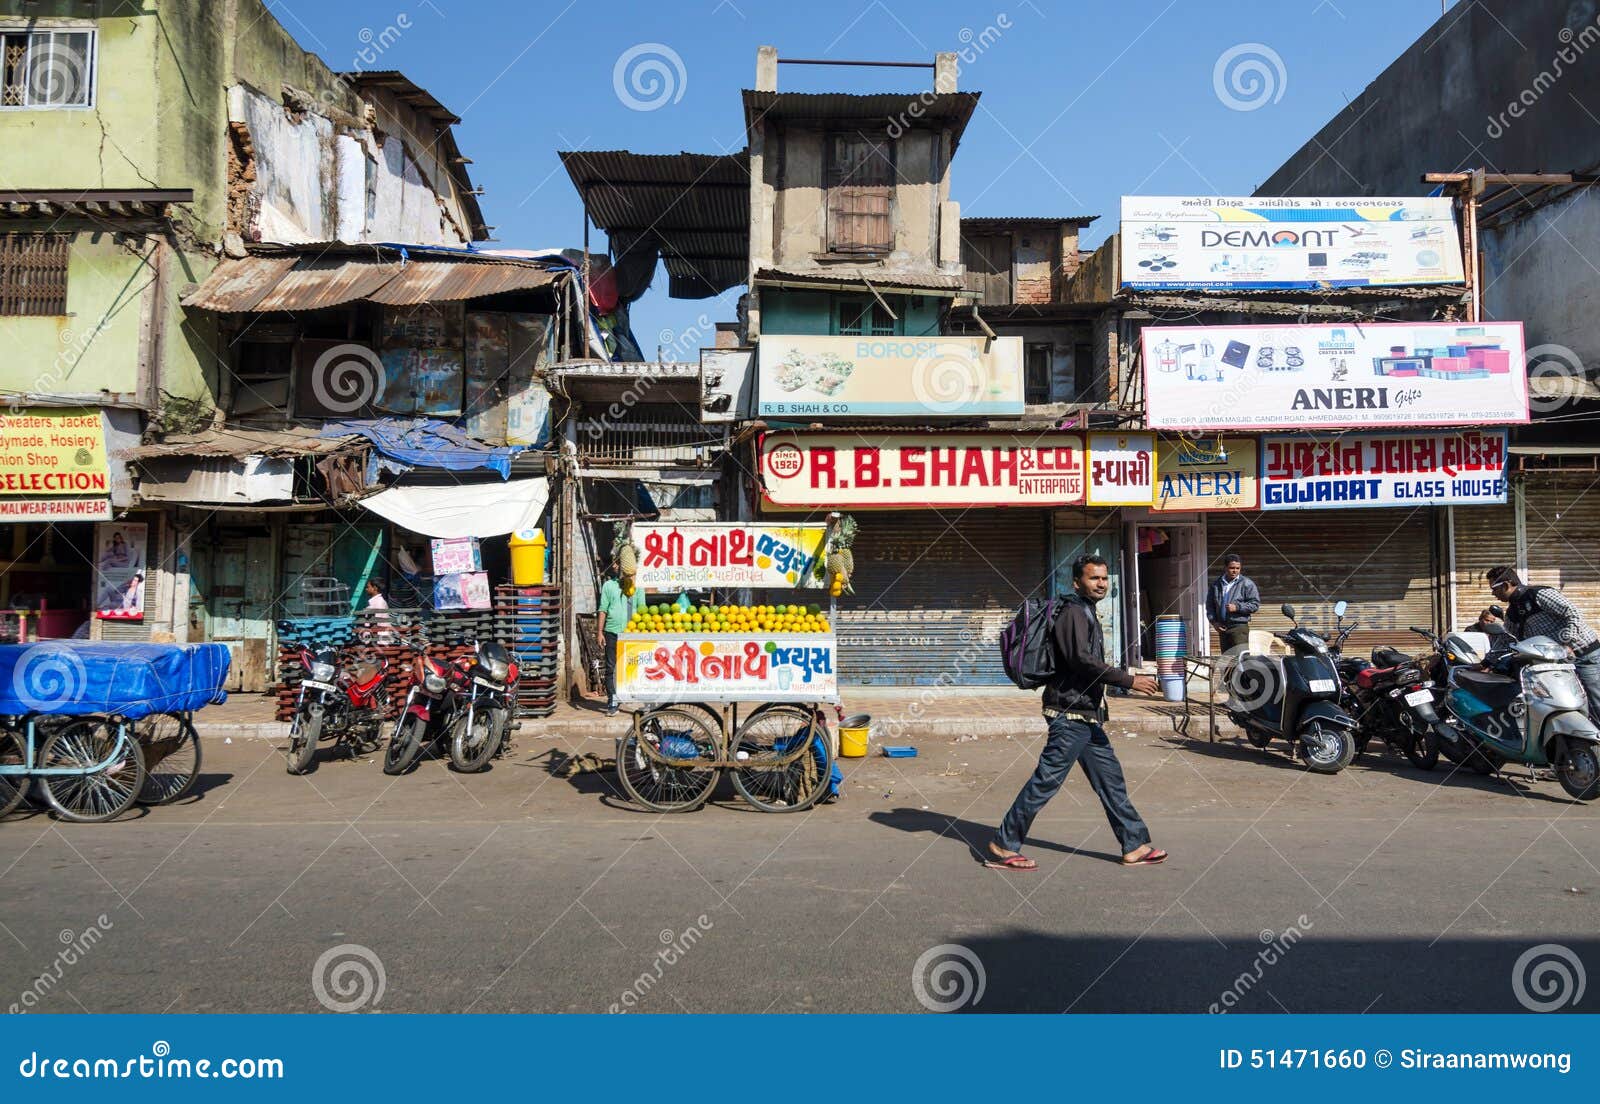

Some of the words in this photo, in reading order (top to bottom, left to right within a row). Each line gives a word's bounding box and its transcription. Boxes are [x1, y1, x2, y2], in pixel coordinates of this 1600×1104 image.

[1201, 230, 1339, 247] DEMONT
[857, 342, 944, 359] BOROSIL
[1291, 387, 1389, 410] ANERI
[1394, 389, 1422, 408] Gifts
[791, 404, 819, 413] SHAH
[823, 404, 829, 413] &
[833, 404, 850, 413] CO.
[27, 452, 58, 468] Shop
[775, 461, 798, 469] 1926
[1268, 440, 1363, 480] ગુજરાત
[1370, 438, 1437, 474] ગ્લાસ
[1092, 450, 1150, 486] સ્વામી
[1019, 478, 1080, 494] ENTERPRISE
[1160, 471, 1241, 498] ANERI
[1265, 479, 1382, 505] GUJARAT
[1394, 481, 1445, 498] GLASS
[1452, 479, 1504, 497] HOUSE
